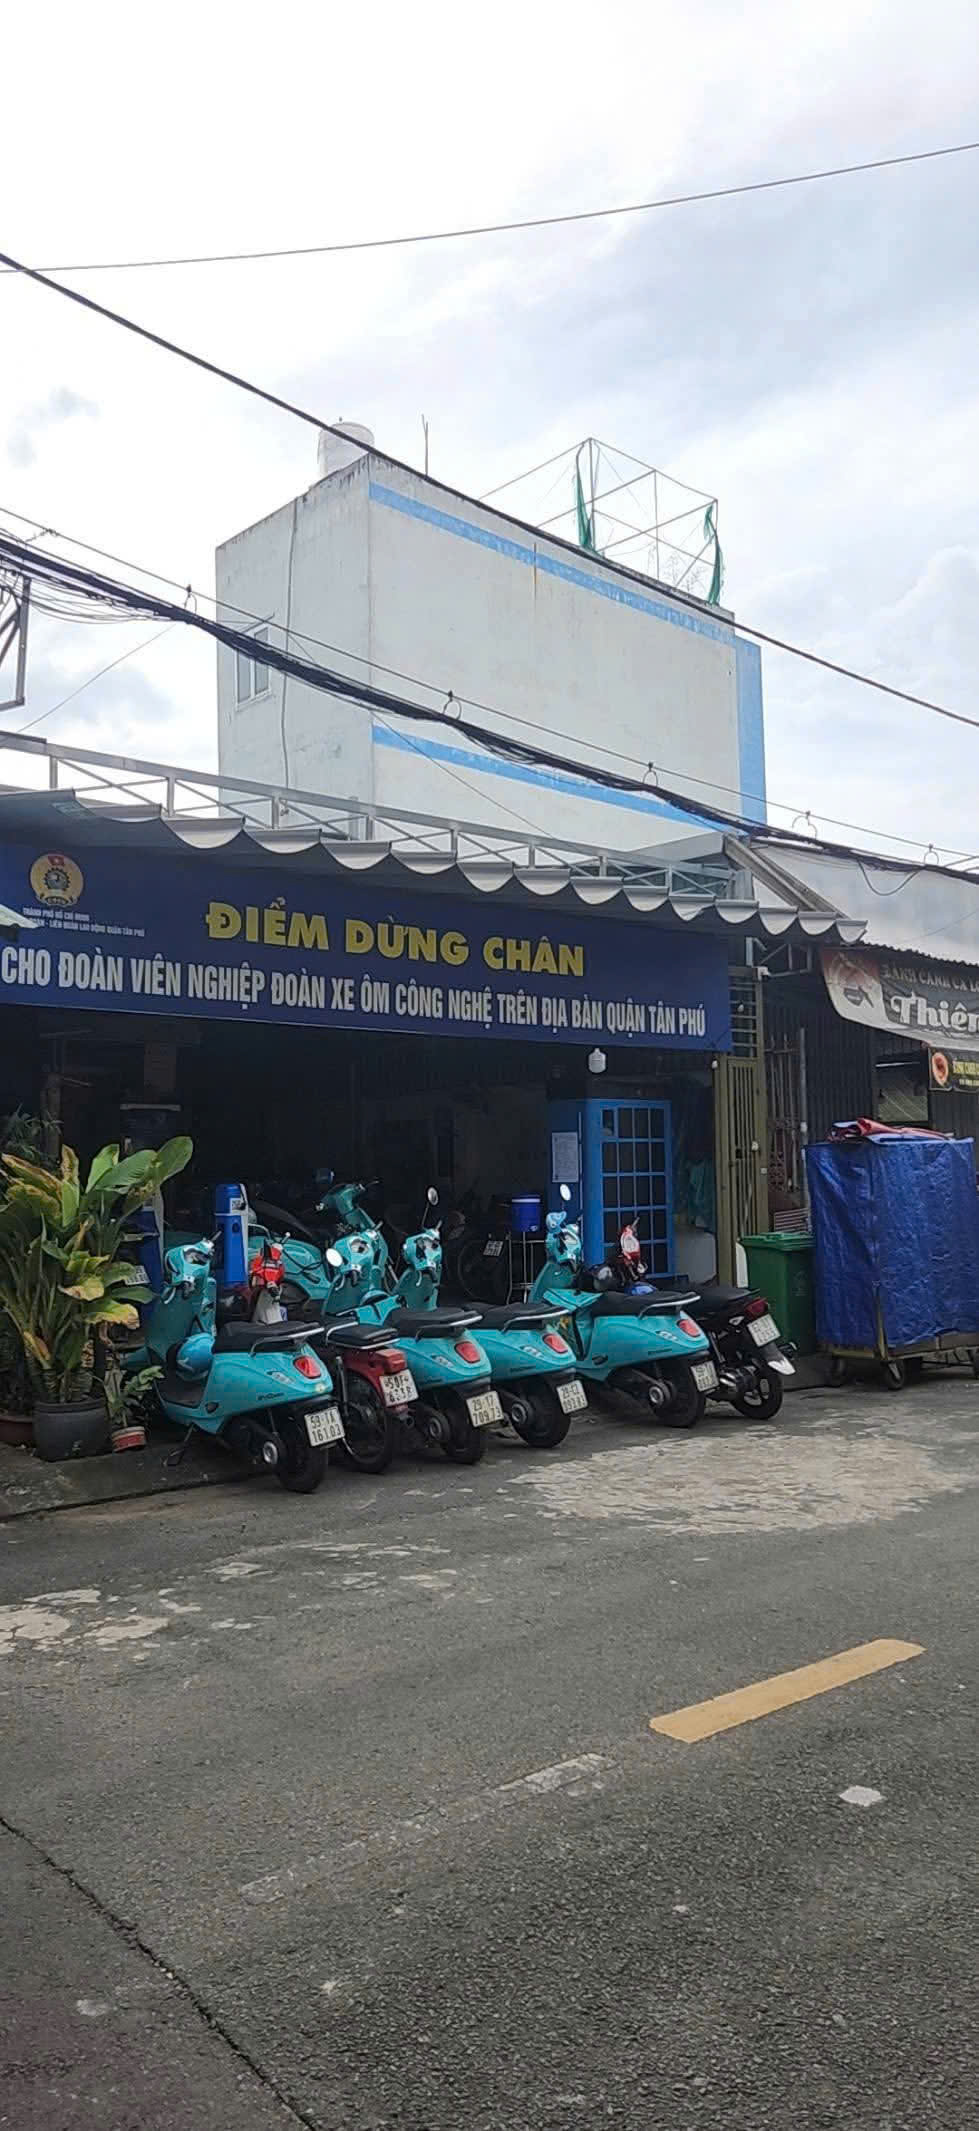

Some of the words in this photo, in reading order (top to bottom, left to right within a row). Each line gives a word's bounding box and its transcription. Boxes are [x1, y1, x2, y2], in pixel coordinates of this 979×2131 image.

[205, 896, 329, 950] ĐIỂM
[345, 914, 469, 966] DỪNG
[483, 935, 584, 977] CHÂN
[1, 946, 51, 987] CHO
[58, 947, 124, 992] ĐOÀN
[130, 953, 181, 997] VIÊN
[188, 961, 265, 1009] NGHIỆP
[271, 967, 325, 1009] ĐOÀN
[331, 977, 355, 1011] XE
[361, 974, 390, 1014] ÔM
[395, 978, 443, 1018] CÔNG
[448, 986, 492, 1029] NGHỆ
[497, 989, 537, 1025] TRÊN
[541, 997, 568, 1033] ĐỊA
[572, 994, 602, 1029] BÀN
[606, 998, 645, 1038] QUẬN
[649, 1001, 675, 1034] TÂN
[679, 1003, 705, 1037] PHÚ
